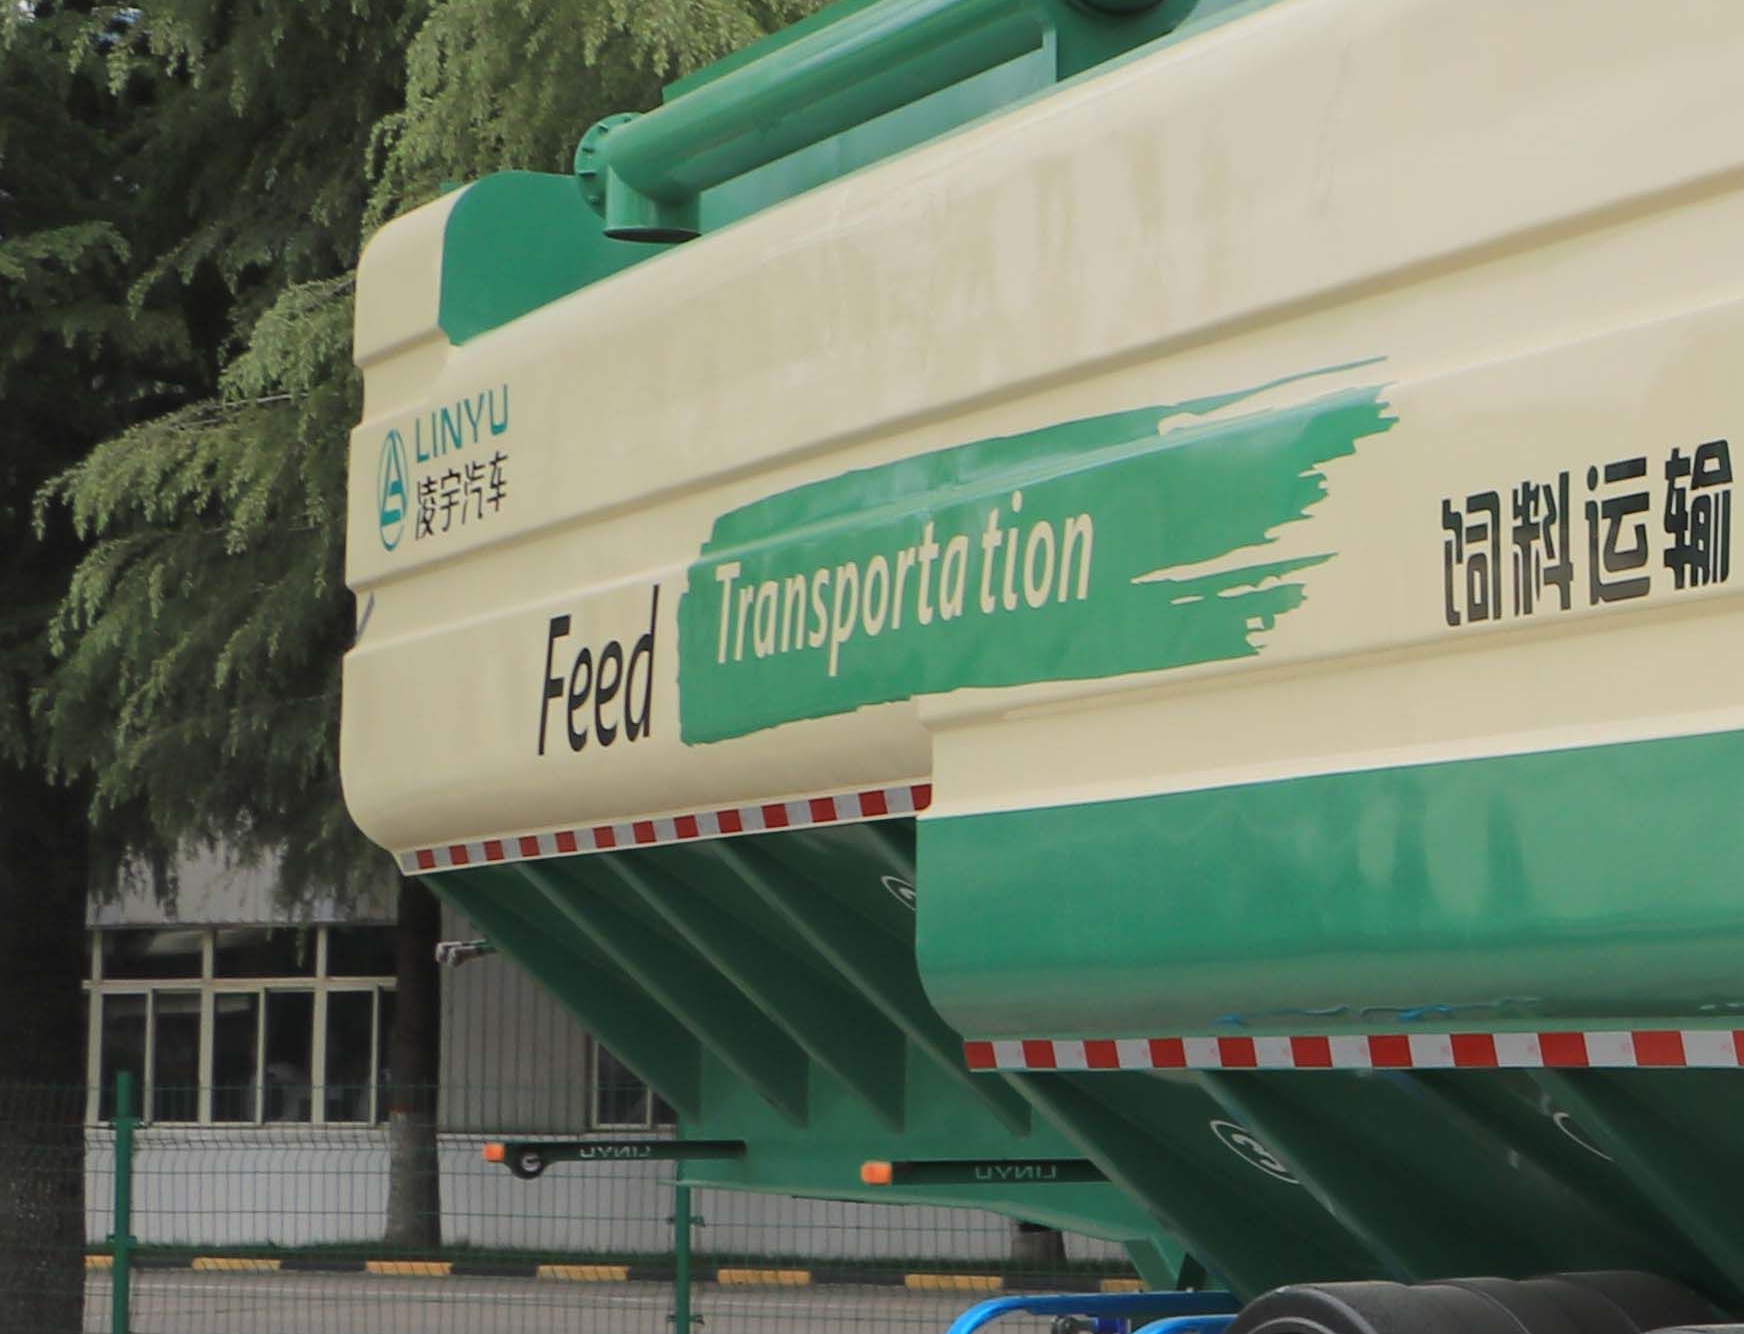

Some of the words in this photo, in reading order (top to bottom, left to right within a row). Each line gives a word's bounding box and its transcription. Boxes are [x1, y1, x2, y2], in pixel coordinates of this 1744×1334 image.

[415, 383, 508, 463] LINYU
[415, 450, 508, 540] 凌宇汽车
[1441, 439, 1734, 627] 饲料运输
[537, 584, 660, 756] Feed
[713, 491, 1095, 677] Transportation
